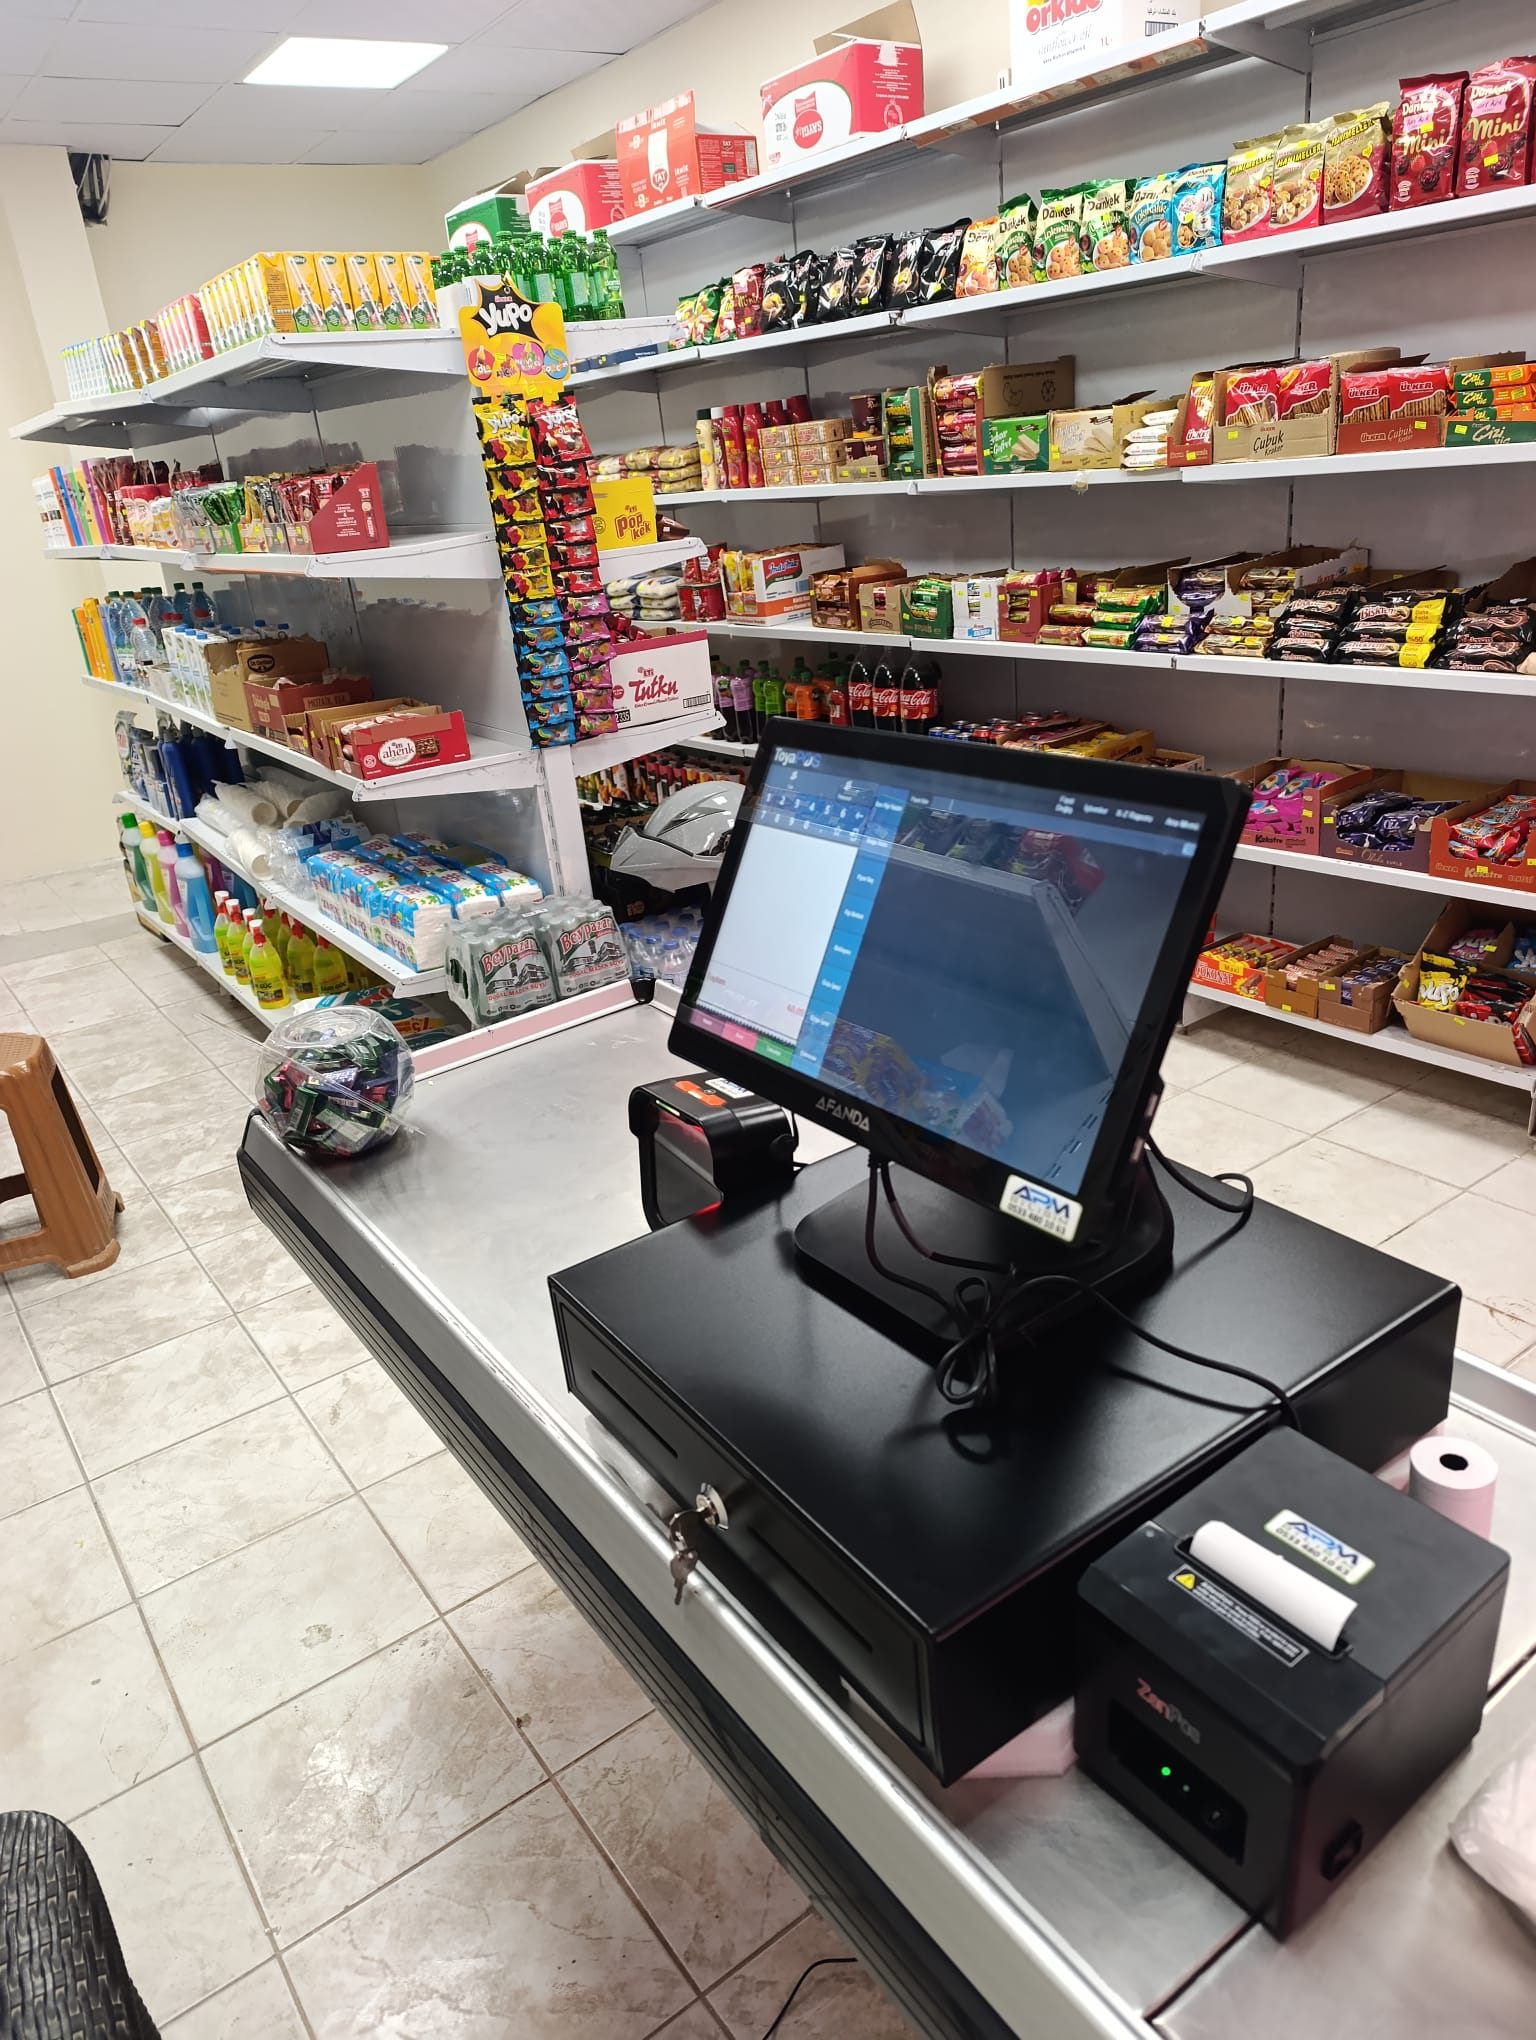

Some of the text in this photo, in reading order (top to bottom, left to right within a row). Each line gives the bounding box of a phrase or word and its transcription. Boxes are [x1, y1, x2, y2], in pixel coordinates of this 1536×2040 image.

[1348, 387, 1379, 398] ÜLKER
[1400, 381, 1433, 392] ÜLKER
[1253, 430, 1285, 454] Çubuk
[628, 674, 679, 702] Tutku
[382, 742, 415, 759] ahenk
[815, 1095, 871, 1132] AFANDA
[1275, 1527, 1350, 1577] 0533 480 10 63
